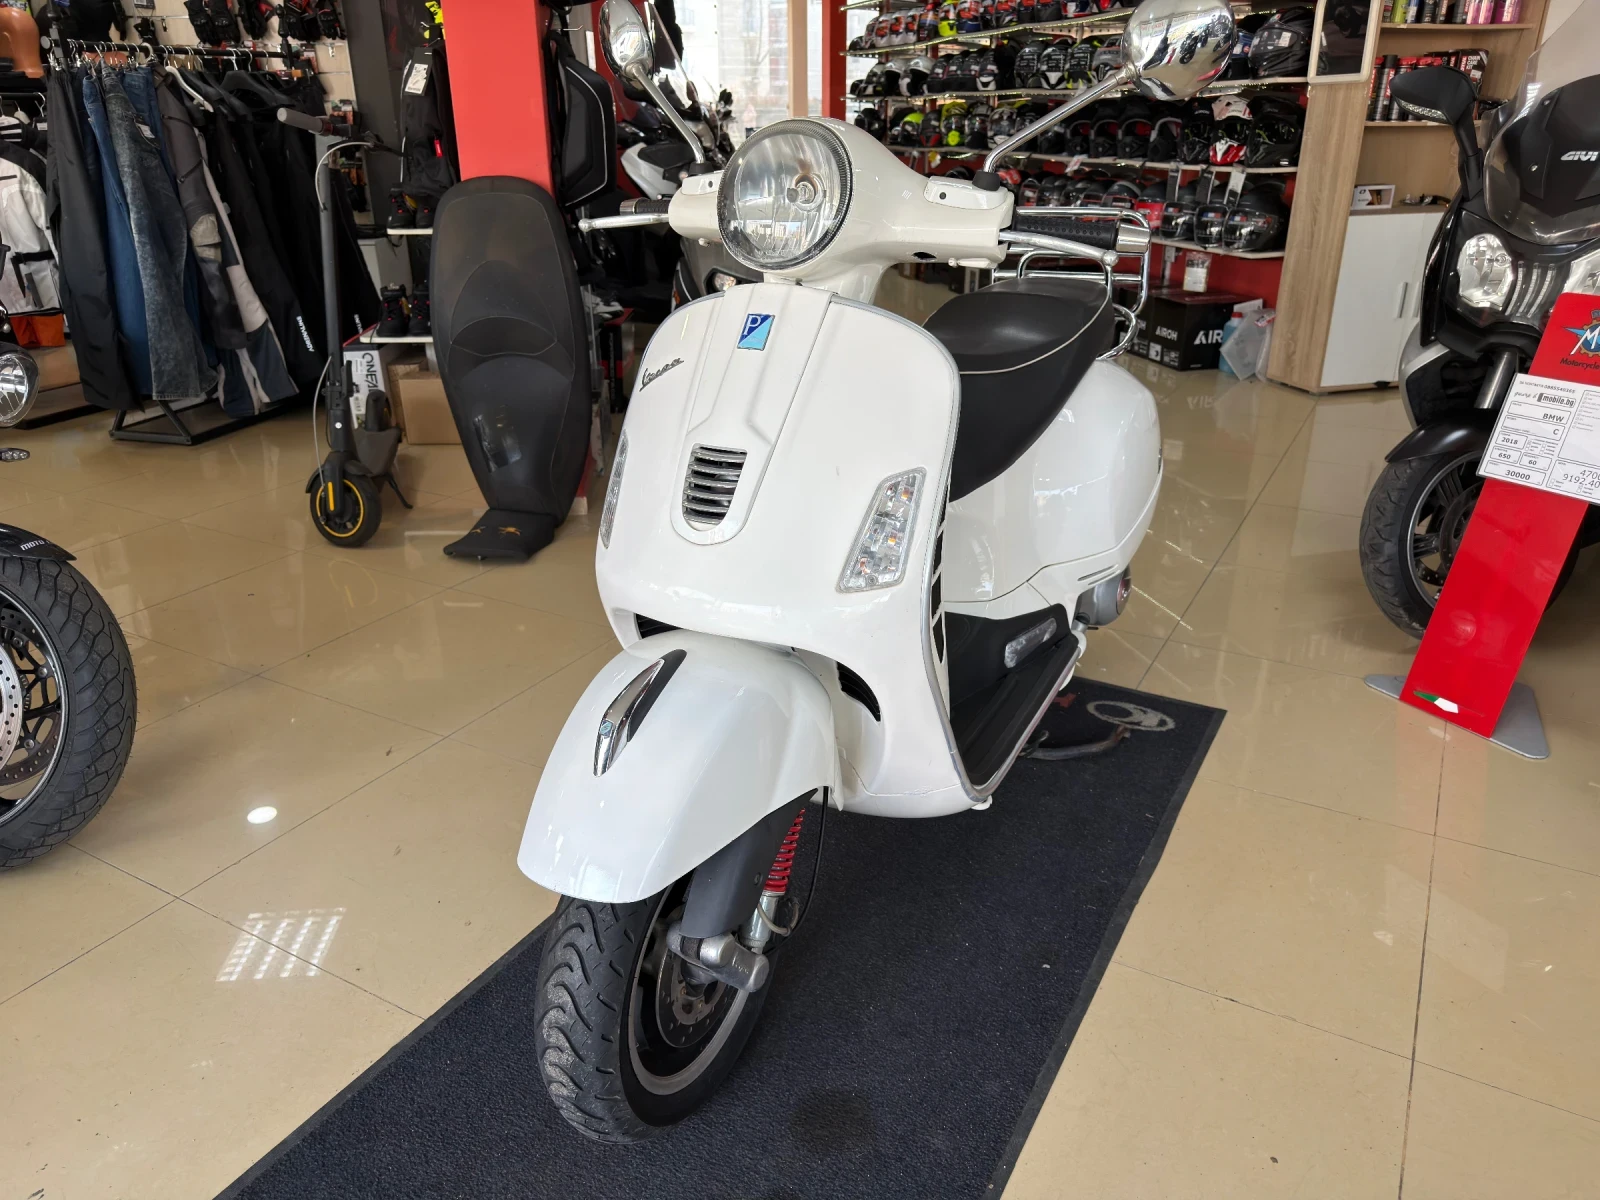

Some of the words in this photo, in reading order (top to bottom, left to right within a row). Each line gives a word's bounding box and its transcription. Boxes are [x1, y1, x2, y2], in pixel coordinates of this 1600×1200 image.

[1560, 151, 1599, 161] GIVI
[297, 315, 315, 352] ADRENALINE
[1155, 325, 1178, 342] AIROH
[1193, 330, 1223, 345] AIR
[639, 357, 685, 392] Vespa
[1542, 395, 1575, 408] mobile.bg
[1542, 413, 1564, 422] BMW
[1552, 428, 1560, 436] C
[1501, 437, 1518, 445] 2018
[1505, 469, 1531, 481] 30000
